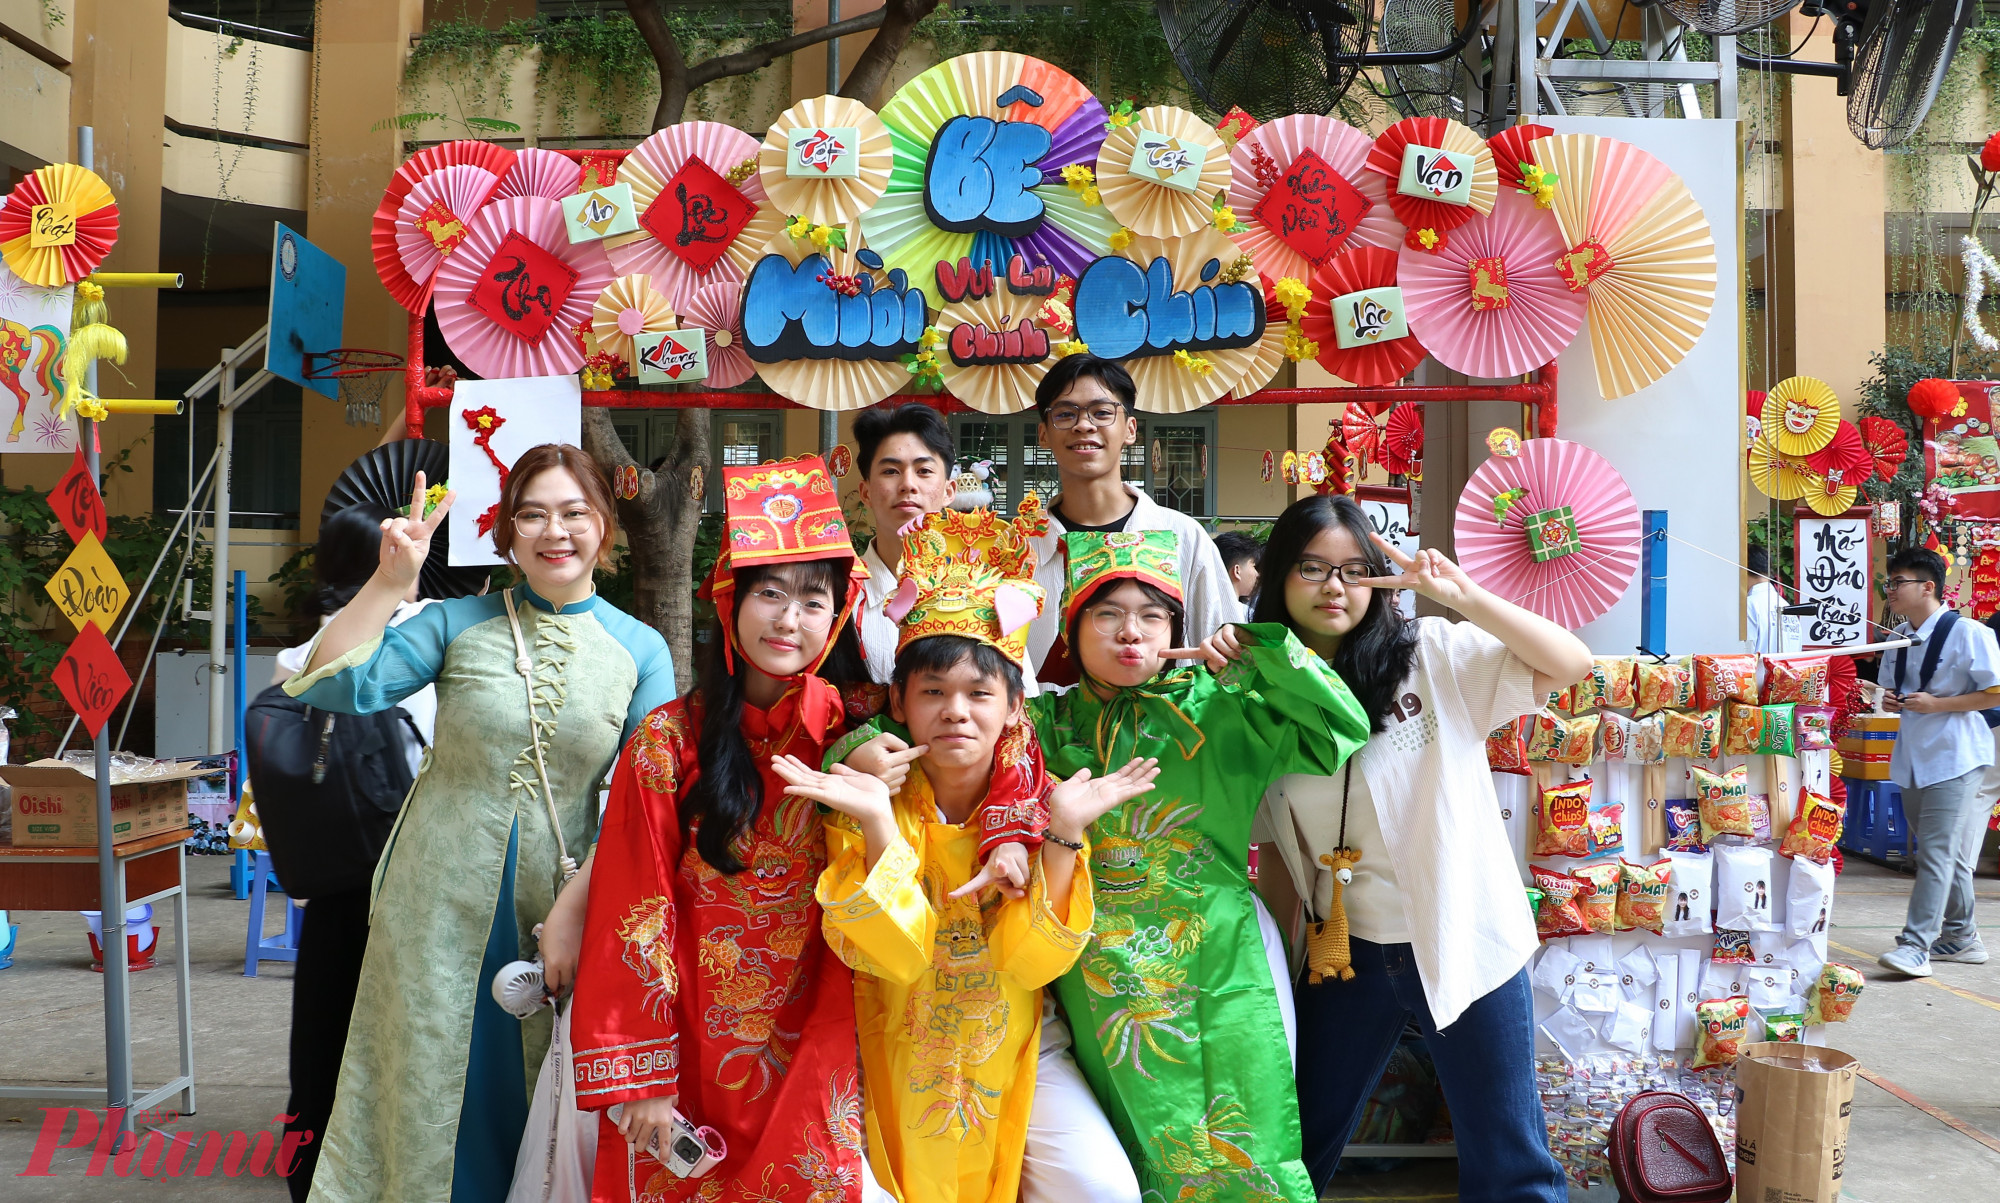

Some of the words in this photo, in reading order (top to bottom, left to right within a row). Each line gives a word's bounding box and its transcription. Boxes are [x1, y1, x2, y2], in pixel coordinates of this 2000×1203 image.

[794, 135, 848, 167] Tết
[1143, 142, 1195, 174] Tết
[935, 256, 994, 303] Vui
[1353, 302, 1391, 338] Lộc
[640, 340, 700, 371] Khang
[948, 315, 1050, 367] Chính
[1804, 556, 1865, 593] Đáo
[58, 565, 119, 617] Đoàn
[19, 795, 62, 815] Oishi
[1553, 797, 1581, 810] INDO
[1813, 806, 1837, 823] INDO
[1541, 877, 1572, 891] Oishi
